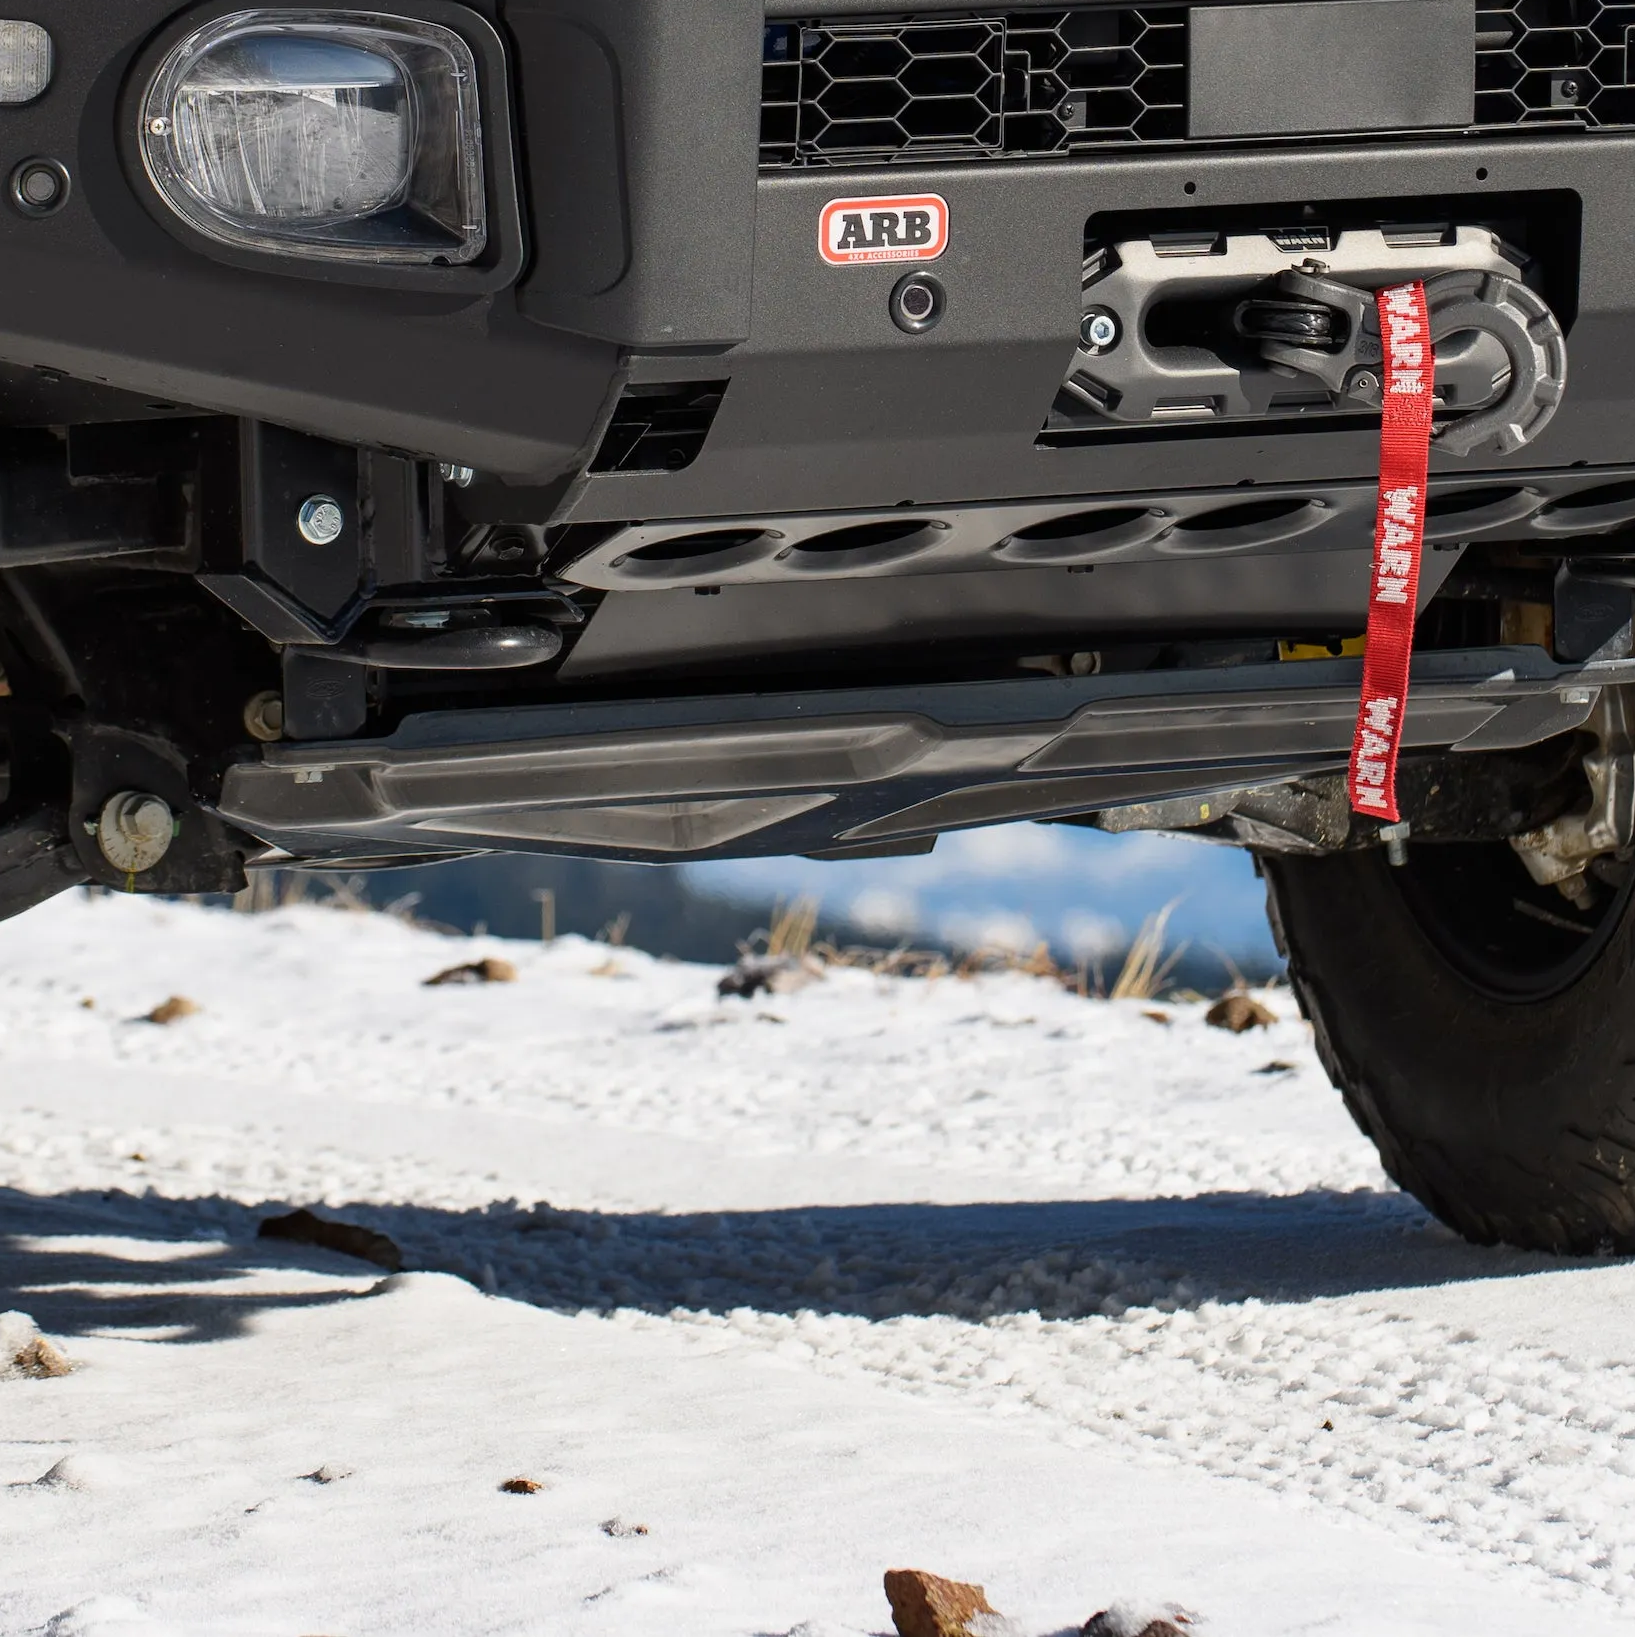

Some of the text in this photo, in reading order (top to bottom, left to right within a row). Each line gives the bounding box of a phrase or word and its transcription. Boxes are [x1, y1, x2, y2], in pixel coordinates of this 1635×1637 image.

[837, 210, 932, 250] ARB
[847, 249, 920, 261] 4X4 ACCESSORIES
[1275, 234, 1327, 246] WARN
[1383, 282, 1426, 395] WARN
[1375, 485, 1418, 605] WARN
[1354, 696, 1399, 810] WARN
